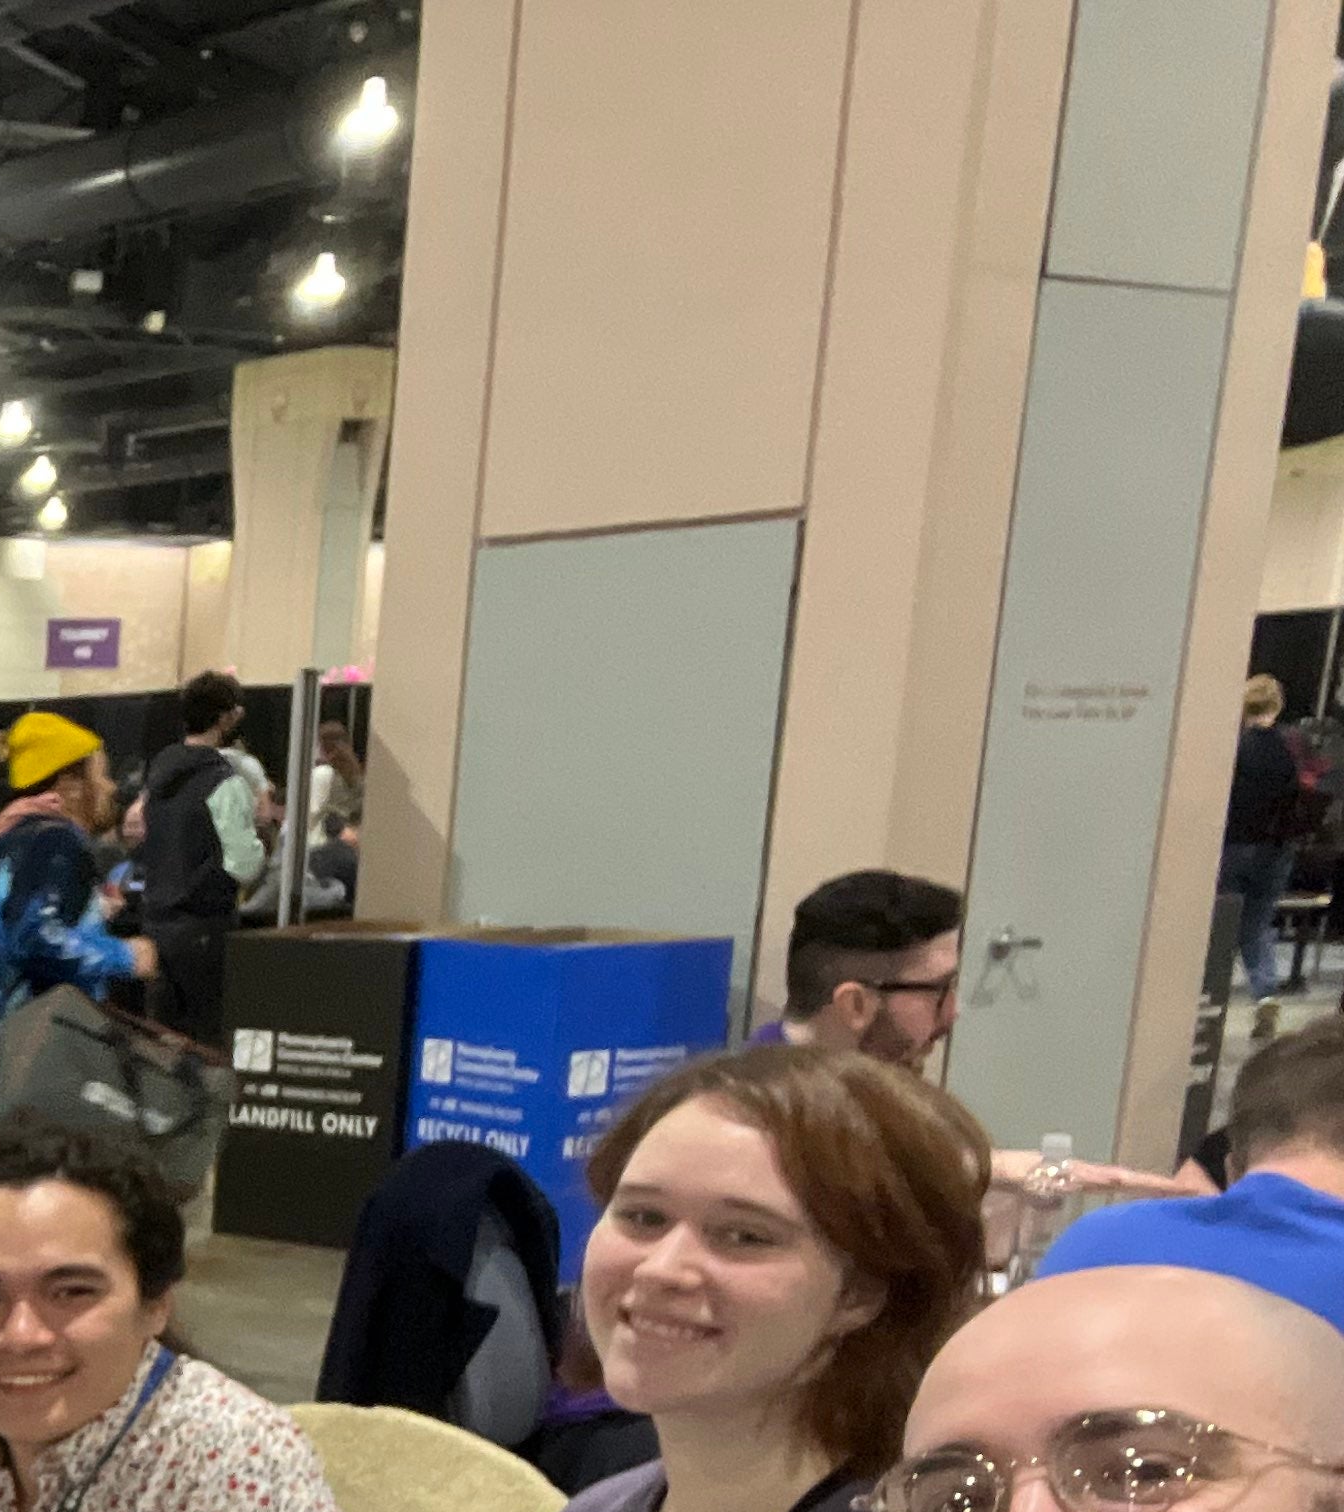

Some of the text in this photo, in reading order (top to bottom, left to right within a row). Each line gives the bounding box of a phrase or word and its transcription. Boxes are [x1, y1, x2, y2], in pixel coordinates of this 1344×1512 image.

[229, 1103, 379, 1138] LANDFILL ONLY
[485, 1130, 529, 1157] ONLY
